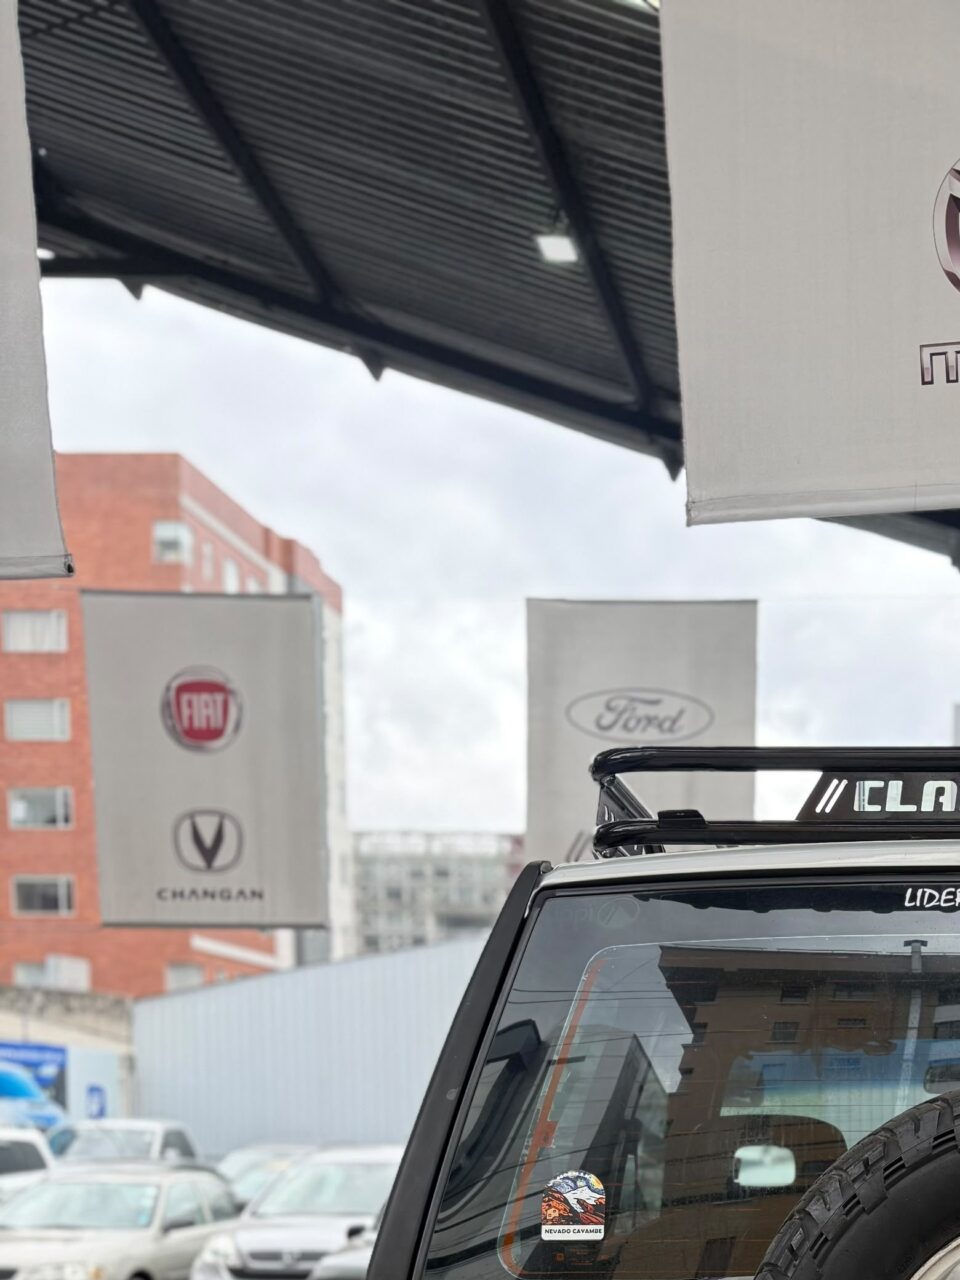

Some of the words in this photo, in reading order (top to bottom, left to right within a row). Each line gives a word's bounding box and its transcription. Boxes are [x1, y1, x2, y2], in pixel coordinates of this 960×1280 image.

[179, 691, 226, 731] FIAT
[595, 693, 686, 733] Ford
[156, 886, 265, 903] CHANGAN
